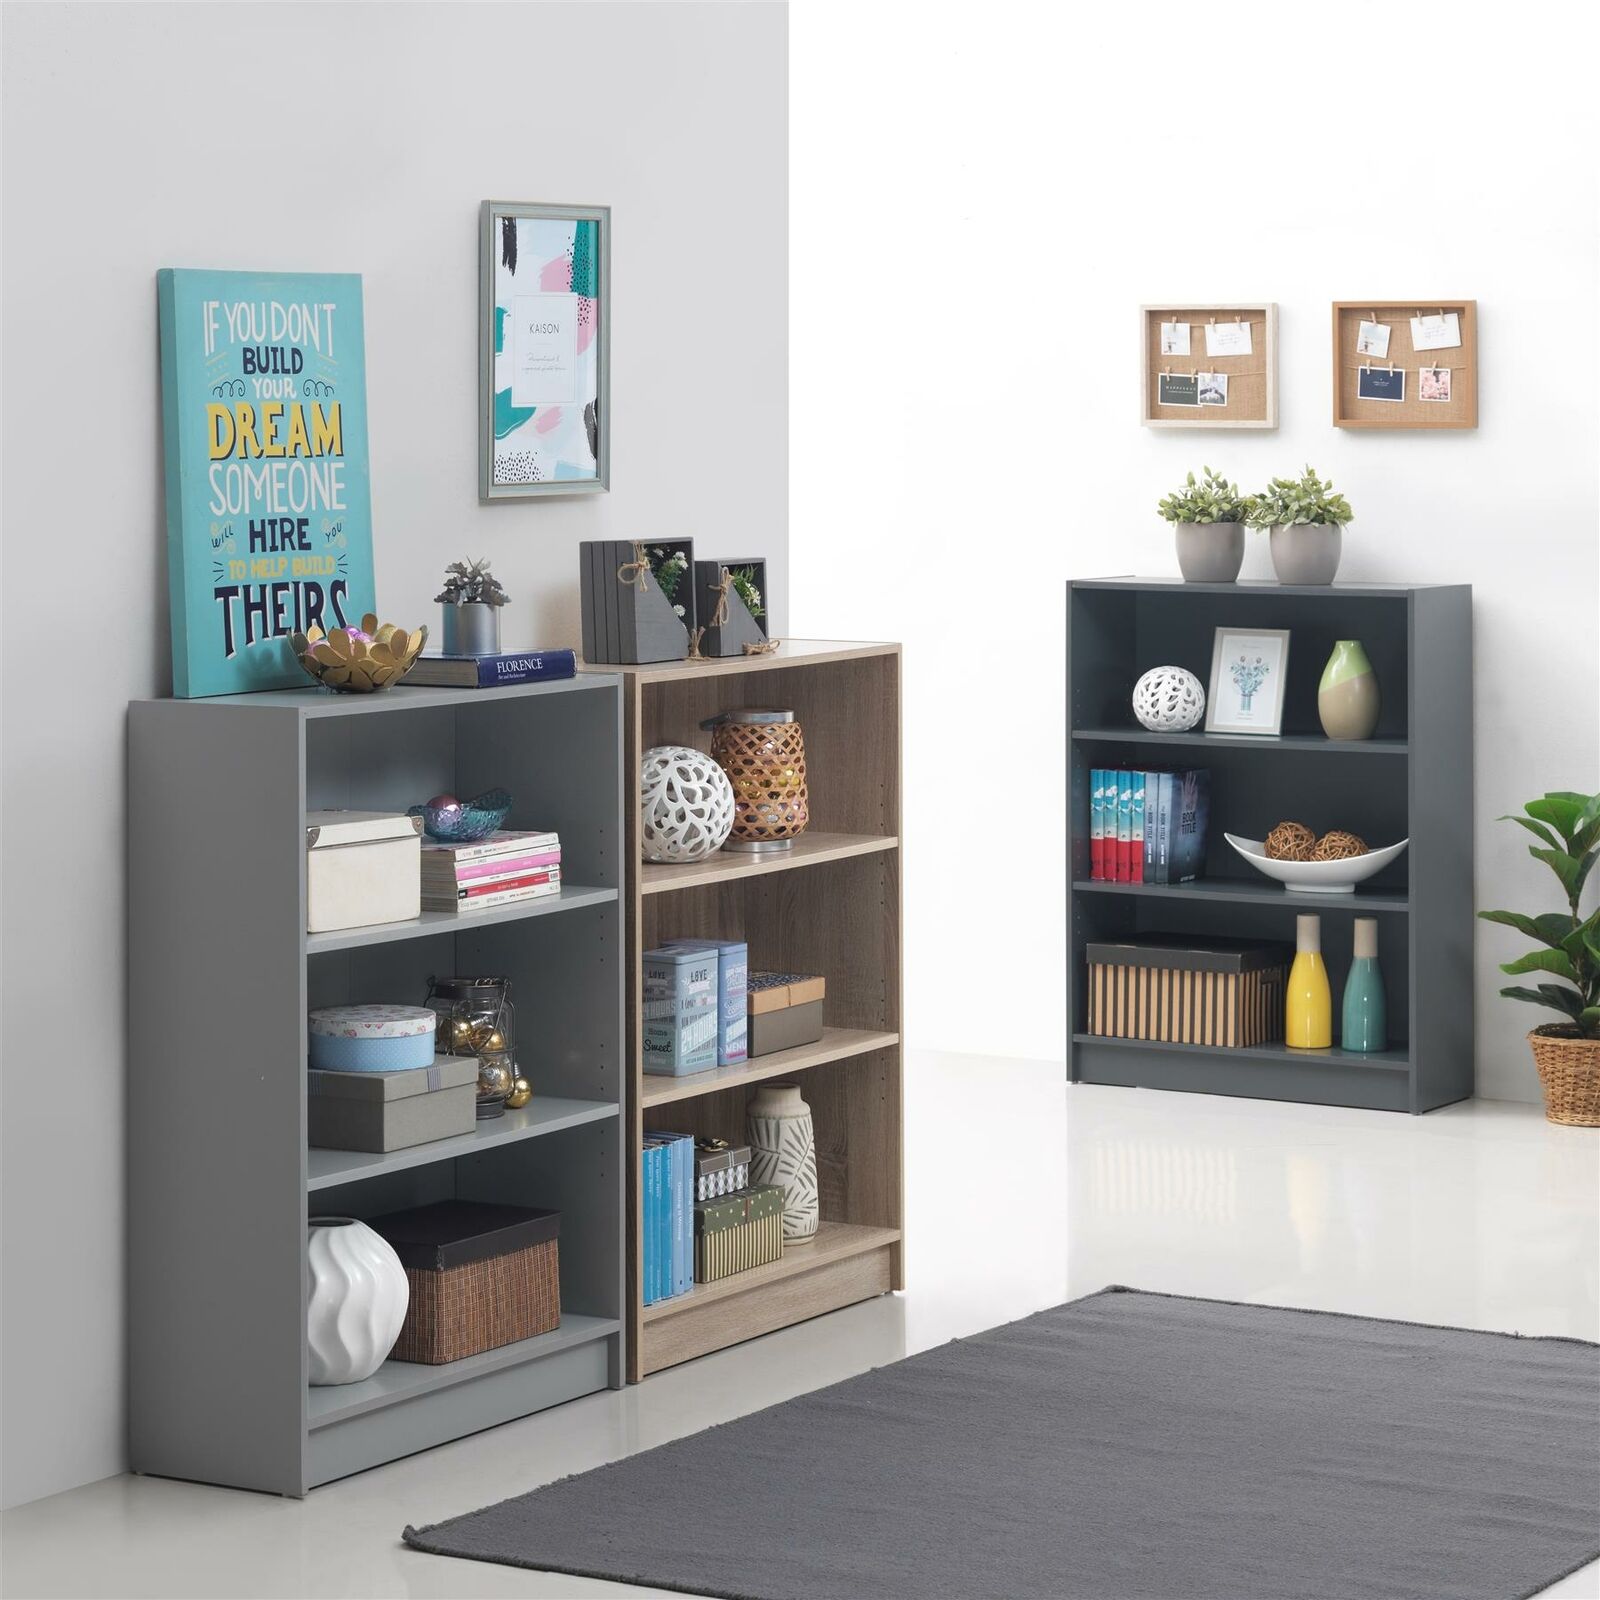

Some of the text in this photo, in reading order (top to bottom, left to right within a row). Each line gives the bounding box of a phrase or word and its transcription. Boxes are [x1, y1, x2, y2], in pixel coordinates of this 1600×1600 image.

[203, 301, 336, 357] IF YOU DON'T
[529, 323, 560, 334] KAISON
[242, 346, 304, 375] BUILD
[252, 377, 297, 399] YOUR
[206, 400, 344, 461] DREAM
[208, 461, 347, 516] SOMEONE
[211, 517, 342, 553] WILL HIRE YOU
[228, 556, 337, 580] TO HELP BUILD
[214, 579, 349, 660] THEIRS
[496, 658, 543, 673] FLORENCE
[690, 968, 707, 983] LOVE
[643, 1039, 673, 1053] Sweet
